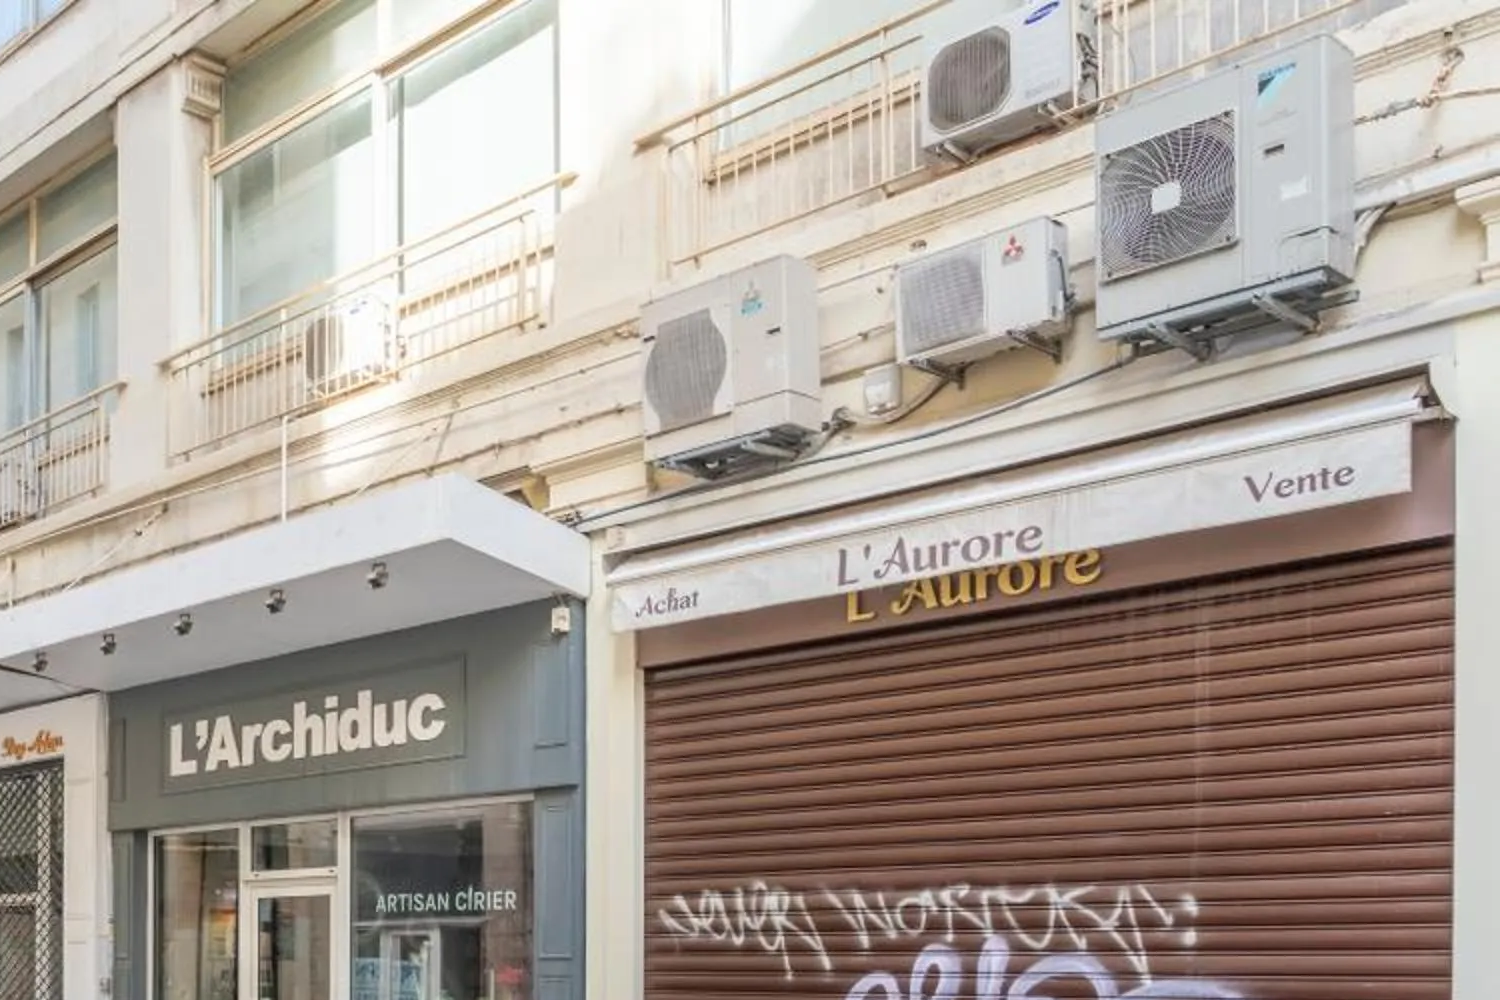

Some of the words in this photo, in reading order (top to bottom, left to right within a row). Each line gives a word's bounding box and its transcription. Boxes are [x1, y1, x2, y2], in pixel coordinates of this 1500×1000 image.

[1243, 465, 1356, 503] Vente
[837, 524, 1044, 587] L'Aurore
[635, 587, 699, 618] Achat
[169, 689, 446, 777] L'Archiduc
[375, 892, 450, 913] ARTISAN
